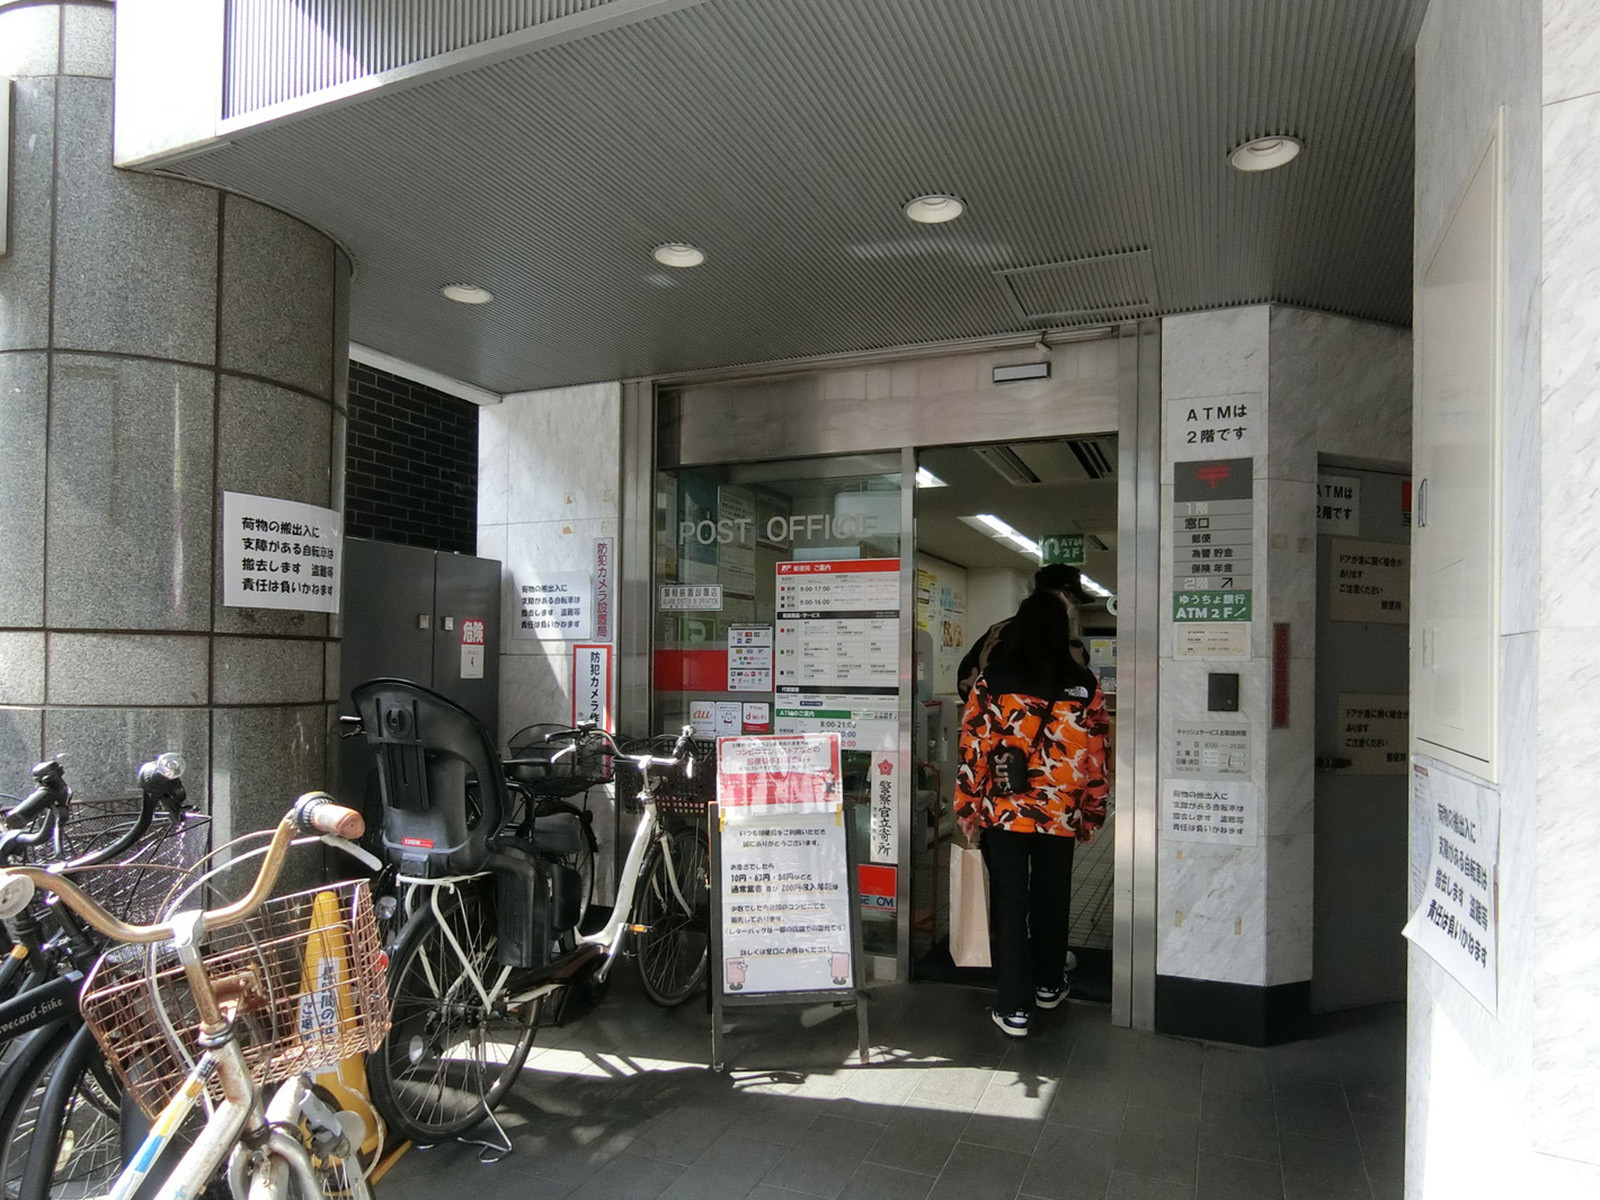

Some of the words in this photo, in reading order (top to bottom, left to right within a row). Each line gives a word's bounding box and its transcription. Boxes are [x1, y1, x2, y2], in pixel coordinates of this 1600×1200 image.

[1186, 404, 1247, 422] ATMは
[1187, 426, 1247, 444] 2階です
[242, 516, 320, 539] 荷物の搬出入に
[679, 518, 751, 545] POST
[767, 514, 876, 542] OFFICE
[1184, 517, 1210, 530] 窓口
[1061, 538, 1082, 546] ATM
[1191, 533, 1211, 544] 郵便
[242, 537, 334, 560] 支障がある自転車は
[1063, 548, 1080, 558] 2F
[1191, 548, 1210, 558] 為替
[1213, 548, 1233, 558] 貯金
[242, 557, 301, 574] 撤去します
[311, 563, 334, 579] 盗難等
[1191, 563, 1211, 574] 保険
[1213, 563, 1233, 573] 年金
[242, 577, 333, 596] 責任は負いかねます
[1184, 577, 1209, 590] 2階
[1179, 594, 1246, 605] ゆうちょ銀行
[1176, 607, 1207, 619] ATM
[463, 621, 484, 643] 危険
[693, 710, 713, 719] au
[878, 780, 891, 856] 警察官立寄所
[860, 894, 894, 907] SEOM
[1427, 899, 1486, 969] 責任は負いかねます
